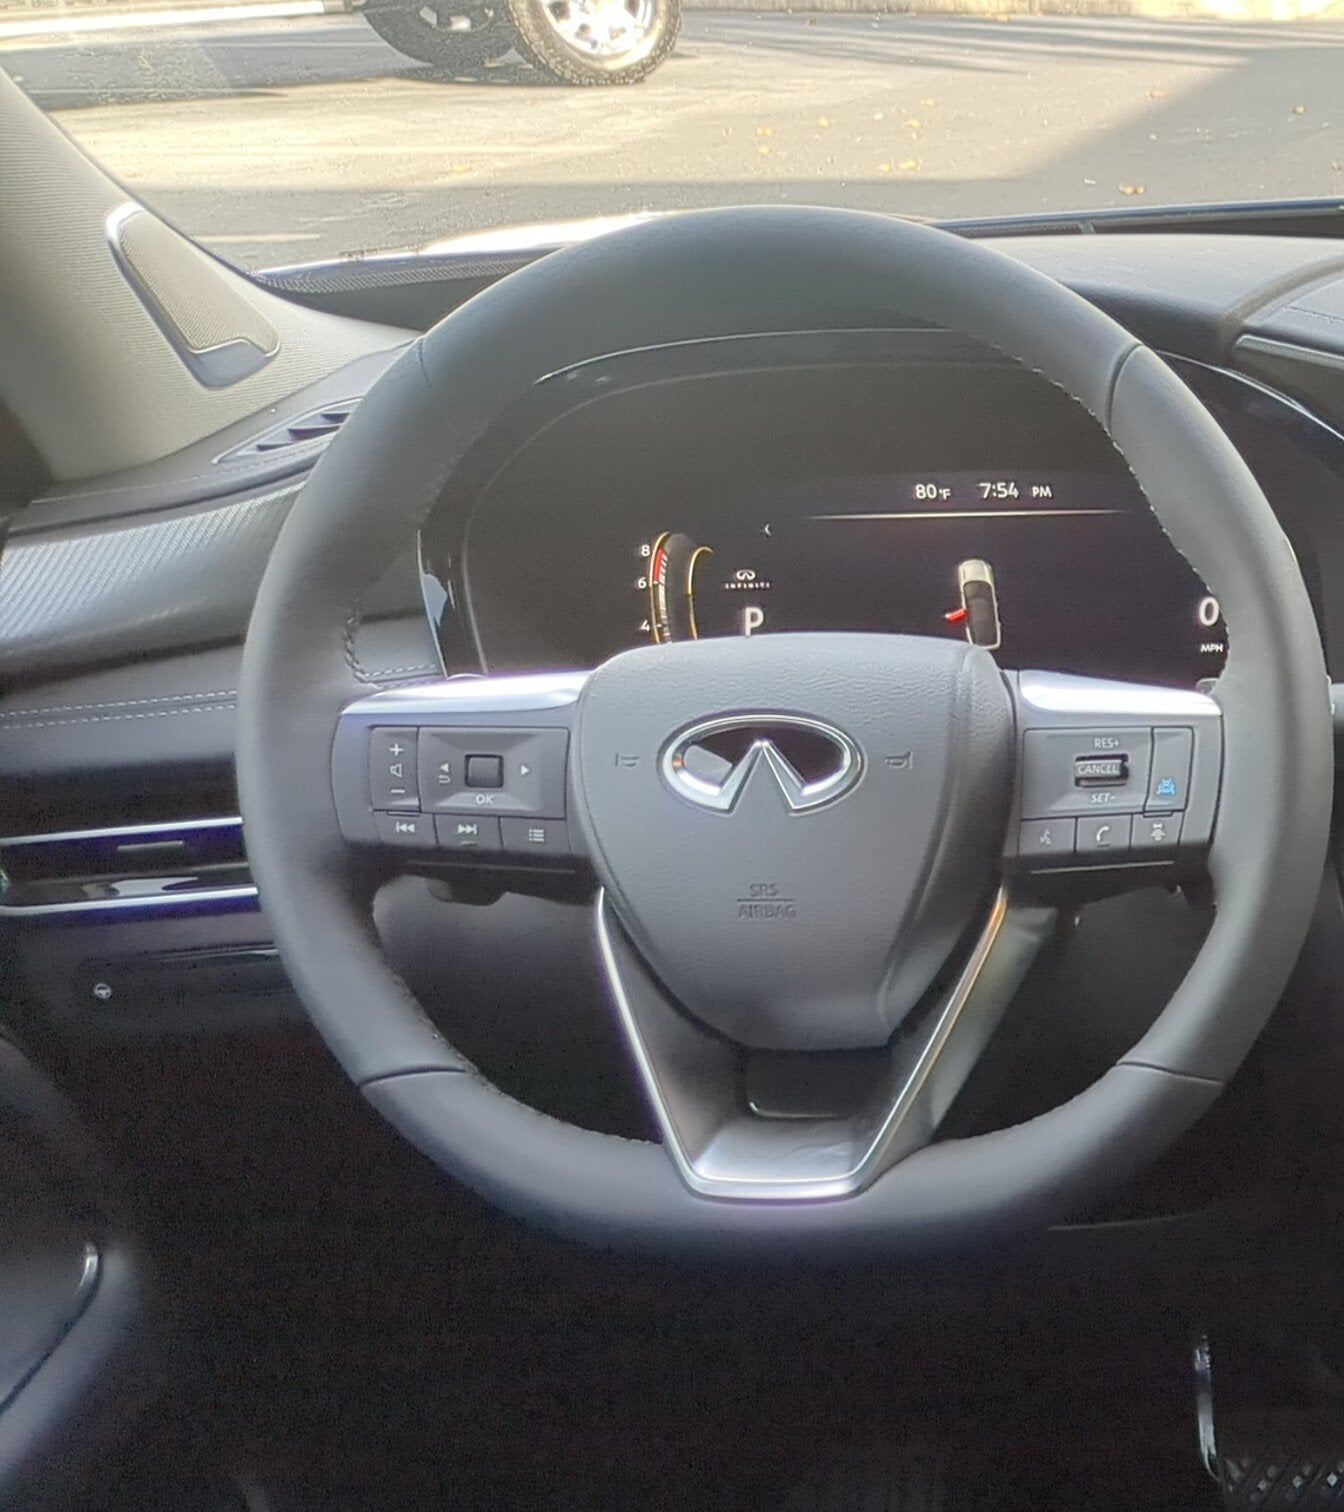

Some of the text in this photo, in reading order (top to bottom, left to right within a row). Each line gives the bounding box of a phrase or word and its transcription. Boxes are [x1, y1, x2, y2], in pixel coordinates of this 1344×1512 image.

[979, 482, 1020, 499] 7:54
[1031, 486, 1053, 498] PM
[641, 544, 651, 557] 8
[637, 576, 647, 589] 6
[1198, 596, 1220, 627] 0
[640, 620, 651, 633] 4
[744, 606, 765, 637] P
[1200, 643, 1224, 653] MPH
[1077, 763, 1119, 776] CANCEL
[475, 794, 494, 805] OK
[749, 883, 778, 898] SRS
[738, 903, 797, 919] AIRBAG
